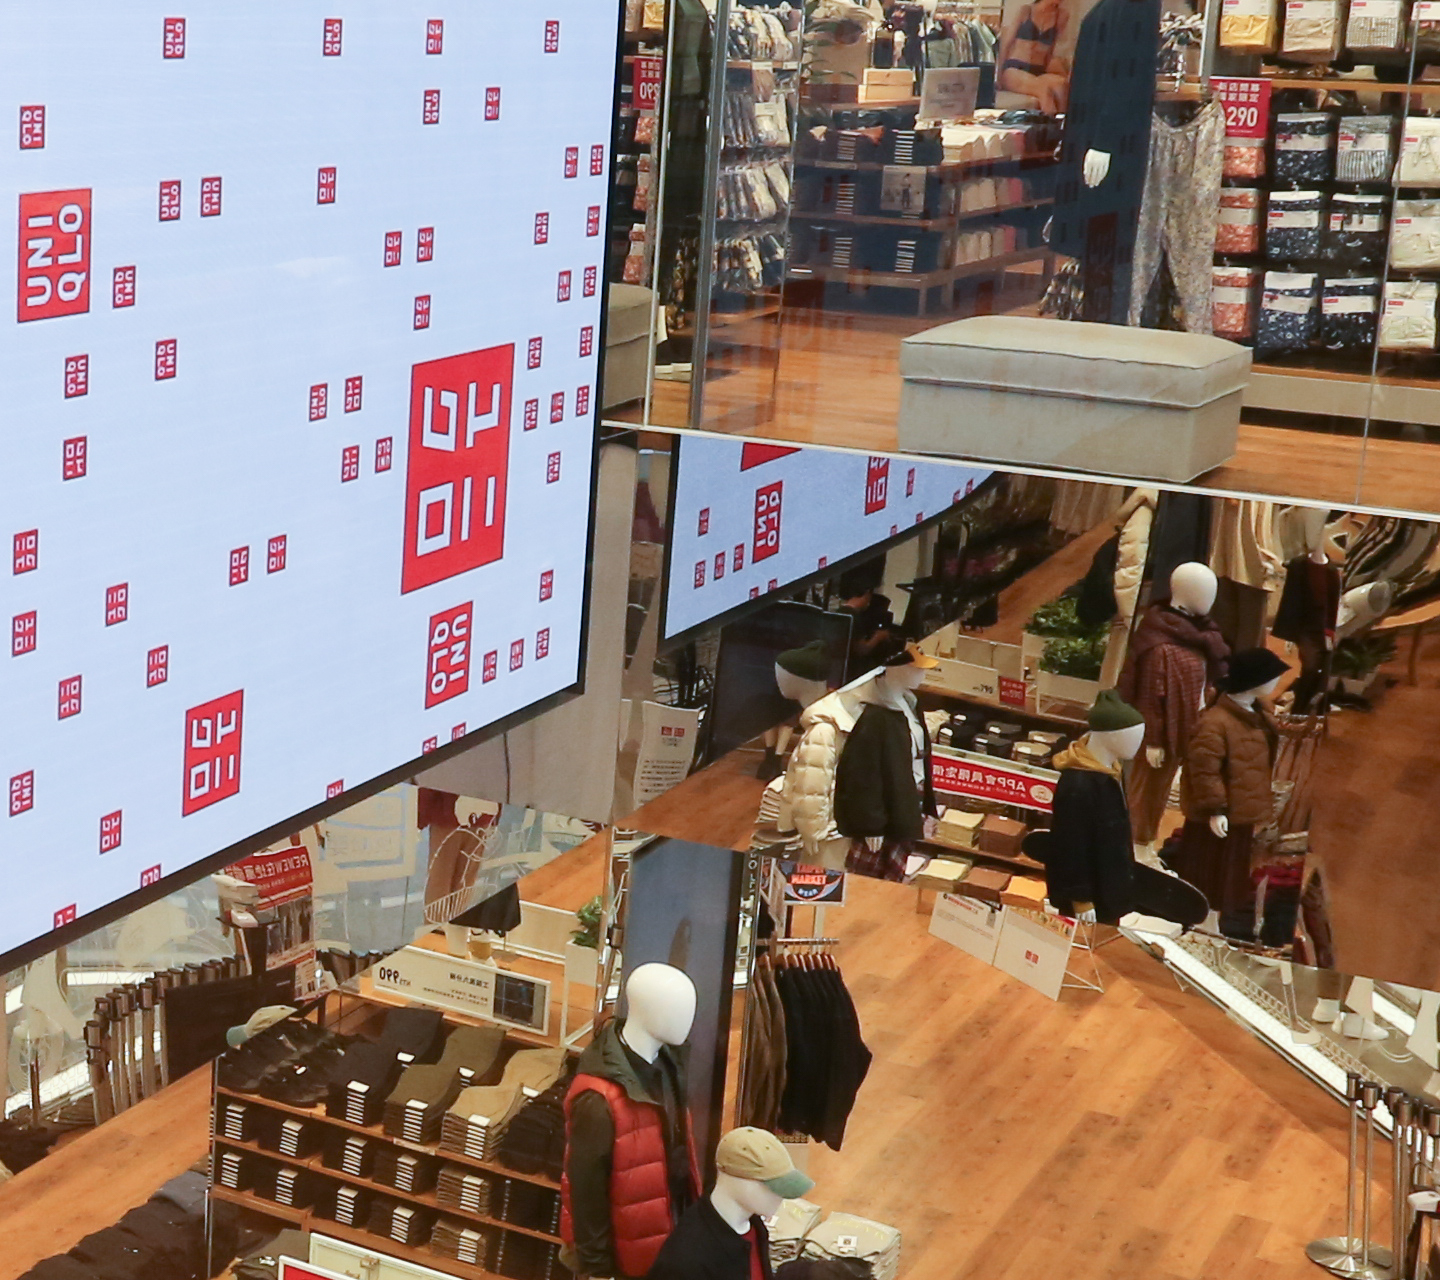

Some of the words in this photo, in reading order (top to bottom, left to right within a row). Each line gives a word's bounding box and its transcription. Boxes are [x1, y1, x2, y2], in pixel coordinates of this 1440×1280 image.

[26, 214, 53, 306] UNI
[56, 203, 85, 301] QLO
[416, 389, 457, 557] クロ
[459, 384, 500, 542] ユニ
[430, 621, 449, 693] QLO
[448, 613, 467, 681] UNI
[191, 719, 212, 797] クロ
[214, 710, 235, 787] ユニ
